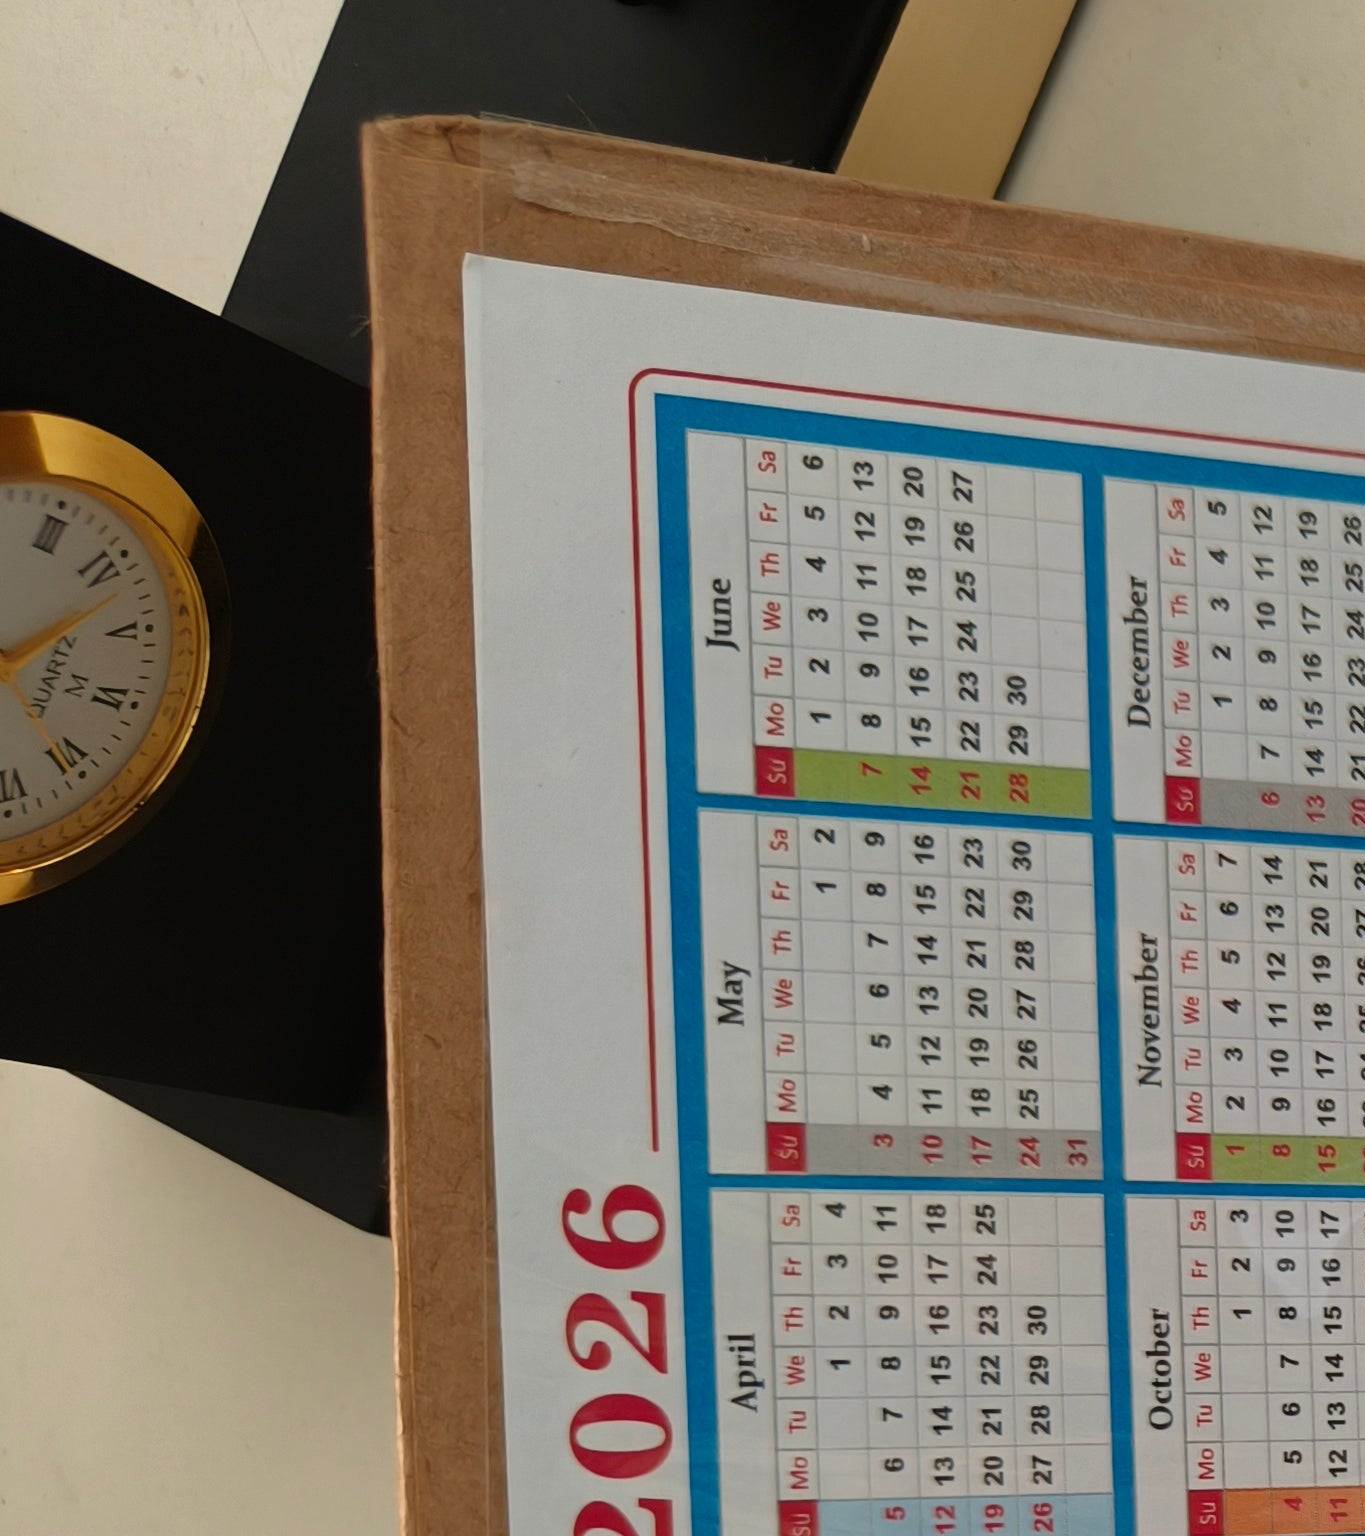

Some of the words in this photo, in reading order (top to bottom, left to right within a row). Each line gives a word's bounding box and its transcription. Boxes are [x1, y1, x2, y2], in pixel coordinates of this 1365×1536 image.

[756, 449, 778, 475] Sa
[851, 460, 876, 492] 13
[757, 501, 779, 524] Fr
[853, 510, 877, 543] 12
[1297, 510, 1319, 540] 19
[31, 513, 69, 556] III
[77, 549, 121, 589] IV
[758, 551, 780, 578] Th
[854, 563, 879, 591] 11
[1298, 557, 1321, 588] 18
[704, 577, 741, 653] June
[761, 599, 783, 633] We
[856, 611, 881, 643] 10
[1300, 603, 1322, 635] 17
[104, 621, 138, 641] V
[1122, 574, 1152, 730] December
[1301, 652, 1323, 683] 16
[29, 635, 78, 719] QUARTZ
[762, 655, 784, 681] Tu
[857, 661, 882, 679] 9
[63, 673, 89, 698] M
[90, 686, 130, 713] VI
[764, 700, 786, 738] Mo
[859, 712, 883, 730] 8
[1302, 699, 1325, 731] 15
[765, 757, 788, 786] Su
[858, 760, 884, 778] 7
[1304, 747, 1326, 778] 14
[1304, 793, 1328, 824] 13
[961, 837, 985, 870] 23
[1176, 851, 1197, 876] Sa
[1216, 851, 1239, 869] 7
[963, 886, 987, 920] 22
[1178, 902, 1198, 924] Fr
[1218, 900, 1240, 917] 6
[964, 939, 988, 970] 21
[1178, 948, 1199, 975] Th
[1219, 948, 1242, 966] 5
[715, 959, 752, 1027] May
[966, 986, 989, 1020] 20
[1220, 997, 1243, 1015] 4
[1132, 931, 1164, 1089] November
[1181, 994, 1201, 1026] We
[967, 1036, 991, 1068] 19
[1182, 1046, 1203, 1073] Tu
[1222, 1046, 1245, 1063] 3
[969, 1086, 992, 1118] 18
[1184, 1089, 1205, 1125] Mo
[1224, 1094, 1246, 1112] 2
[968, 1134, 994, 1166] 17
[1185, 1144, 1206, 1169] Su
[1223, 1143, 1247, 1157] 1
[779, 1203, 802, 1229] Sa
[873, 1205, 899, 1233] 11
[1319, 1209, 1341, 1240] 17
[780, 1256, 803, 1278] Fr
[876, 1253, 900, 1285] 10
[1320, 1257, 1342, 1288] 16
[782, 1305, 804, 1334] Th
[877, 1304, 901, 1321] 9
[1322, 1304, 1344, 1336] 15
[725, 1333, 766, 1413] April
[784, 1354, 807, 1387] We
[879, 1355, 903, 1372] 8
[1144, 1307, 1175, 1432] October
[1323, 1352, 1346, 1384] 14
[786, 1409, 808, 1436] Tu
[880, 1406, 904, 1423] 7
[1325, 1400, 1348, 1431] 13
[788, 1455, 810, 1492] Mo
[882, 1456, 906, 1474] 6
[1327, 1448, 1349, 1479] 12
[882, 1504, 908, 1522] 5
[1327, 1495, 1351, 1524] 11
